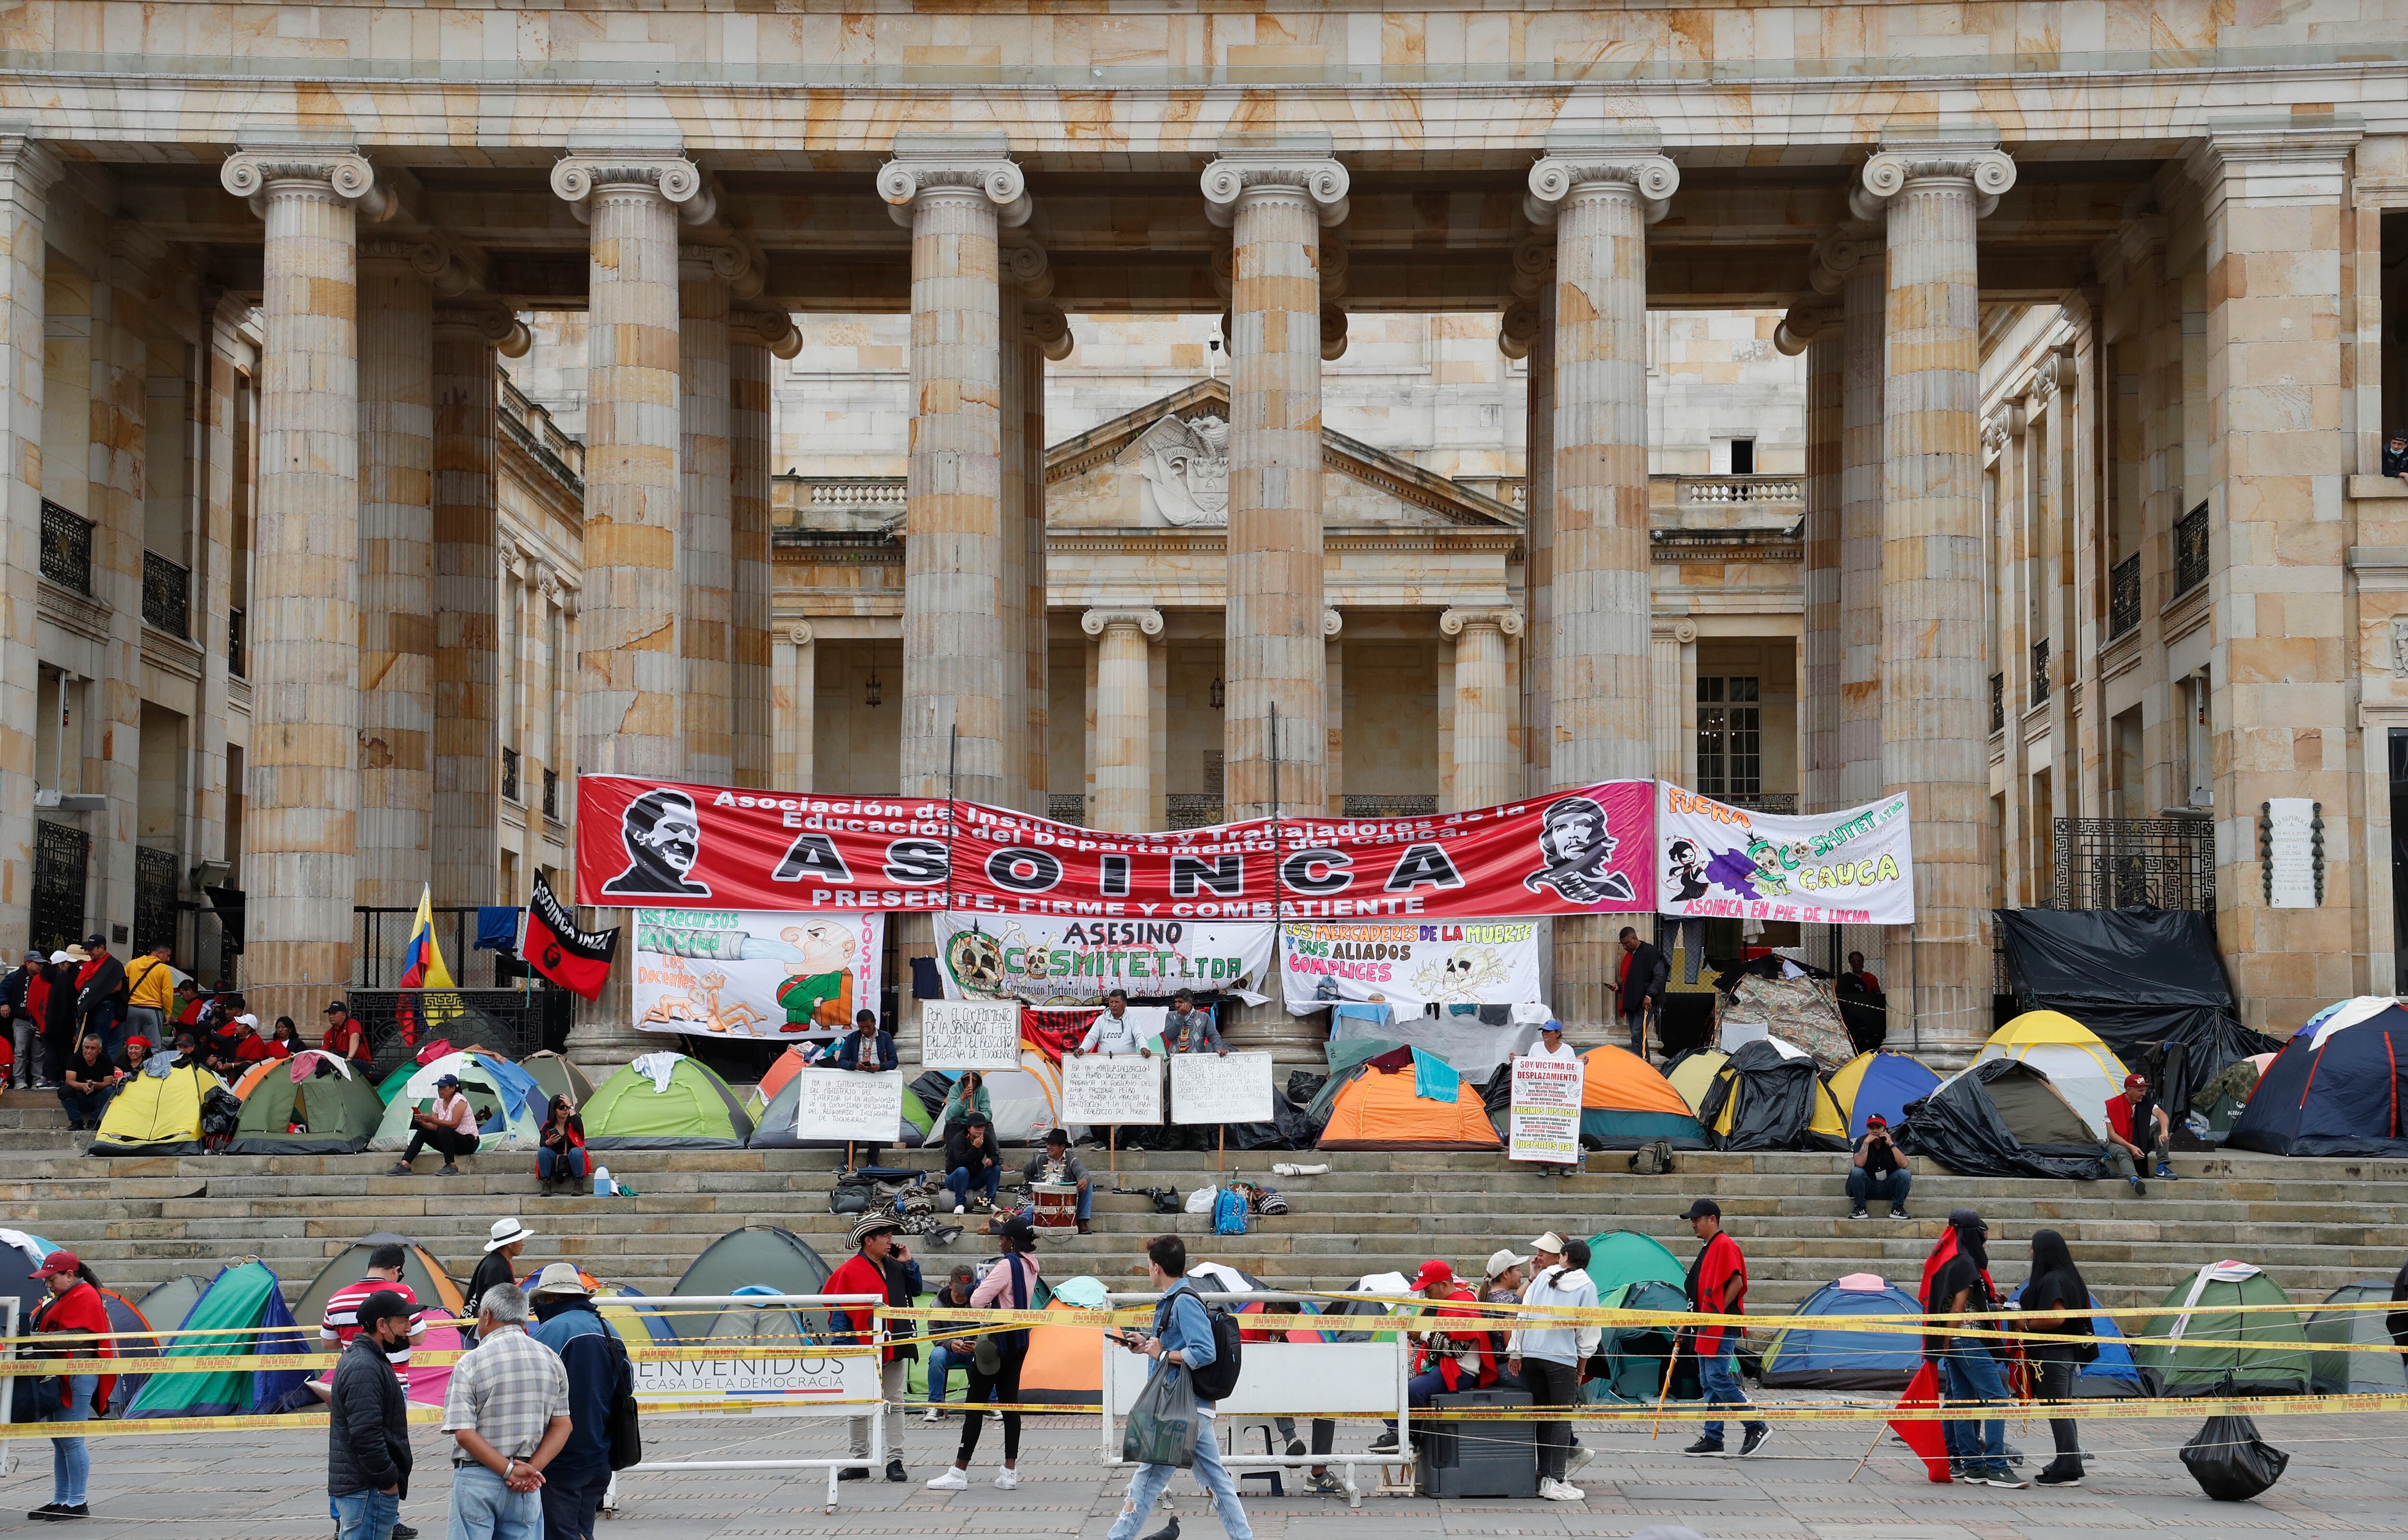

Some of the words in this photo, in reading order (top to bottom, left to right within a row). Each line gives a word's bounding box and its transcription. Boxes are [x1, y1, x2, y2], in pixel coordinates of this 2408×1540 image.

[1669, 787, 1752, 828] FUERA
[713, 791, 903, 818] Asociación
[915, 803, 955, 820] de
[967, 807, 1165, 843] Institutores
[1177, 834, 1196, 846] y
[1206, 821, 1432, 842] Trabajadores
[1444, 814, 1484, 824] de
[1496, 805, 1526, 818] la
[2282, 815, 2308, 826] REPUBLICA
[783, 812, 959, 837] Educación
[971, 825, 1021, 843] del
[1034, 832, 1276, 854] Departamento
[1289, 838, 1338, 850] del
[1758, 878, 1792, 896] DEL
[1799, 854, 1899, 890] CAUCA
[533, 880, 575, 940] ASOINCA
[811, 889, 1006, 913] PRESENTE,
[1019, 898, 1125, 917] FIRME
[1137, 903, 1160, 917] Y
[1171, 897, 1426, 919] COMBATIENTE
[1683, 899, 1743, 917] ASOINCA
[1750, 901, 1769, 919] EN
[1775, 904, 1798, 921] PIE
[1804, 908, 1821, 923] DE
[1828, 909, 1871, 923] LUCHA
[638, 909, 661, 925] Los
[664, 909, 738, 929] Recursos
[639, 931, 656, 947] de
[660, 930, 672, 948] la
[676, 932, 720, 951] Salud
[1062, 922, 1182, 946] ASESINO
[1284, 924, 1313, 940] LOS
[1315, 925, 1418, 942] MERCADERES
[1420, 925, 1437, 941] DE
[1442, 926, 1462, 941] LA
[1466, 924, 1533, 944] MUERTE
[1287, 939, 1294, 950] Y
[1298, 940, 1329, 958] SUS
[1332, 943, 1411, 961] ALIADOS
[662, 952, 684, 970] Los
[1182, 958, 1242, 979] LTDA
[1289, 953, 1392, 982] COMPLICES
[638, 966, 696, 989] Docentes
[1006, 981, 1045, 996] Corporación
[1048, 984, 1078, 995] Mortoria
[1083, 985, 1130, 997] Internacl
[928, 1007, 943, 1021] POR
[951, 1008, 960, 1021] EL
[925, 1022, 936, 1034] DE
[939, 1022, 948, 1034] LA
[950, 1020, 986, 1034] SENTENCIA
[991, 1022, 1012, 1034] T-973
[927, 1036, 940, 1047] DEL
[943, 1035, 963, 1047] 2014
[965, 1035, 978, 1048] DEL
[980, 1035, 1015, 1050] RESGUARDO
[969, 1049, 978, 1059] DE
[1535, 1061, 1565, 1070] VICTIMA
[1518, 1071, 1577, 1082] DESPLAZAMIENTO
[1512, 1106, 1544, 1115] EXIGIMOS
[1546, 1107, 1579, 1117] JUSTICIA!
[1515, 1138, 1557, 1150] Queremos
[1559, 1142, 1574, 1151] paz
[640, 1359, 844, 1377] ENVENIDOS
[633, 1380, 641, 1390] A
[646, 1379, 687, 1390] CASA
[693, 1378, 711, 1389] DE
[717, 1378, 735, 1388] LA
[741, 1377, 844, 1388] DEMOCRACIA
